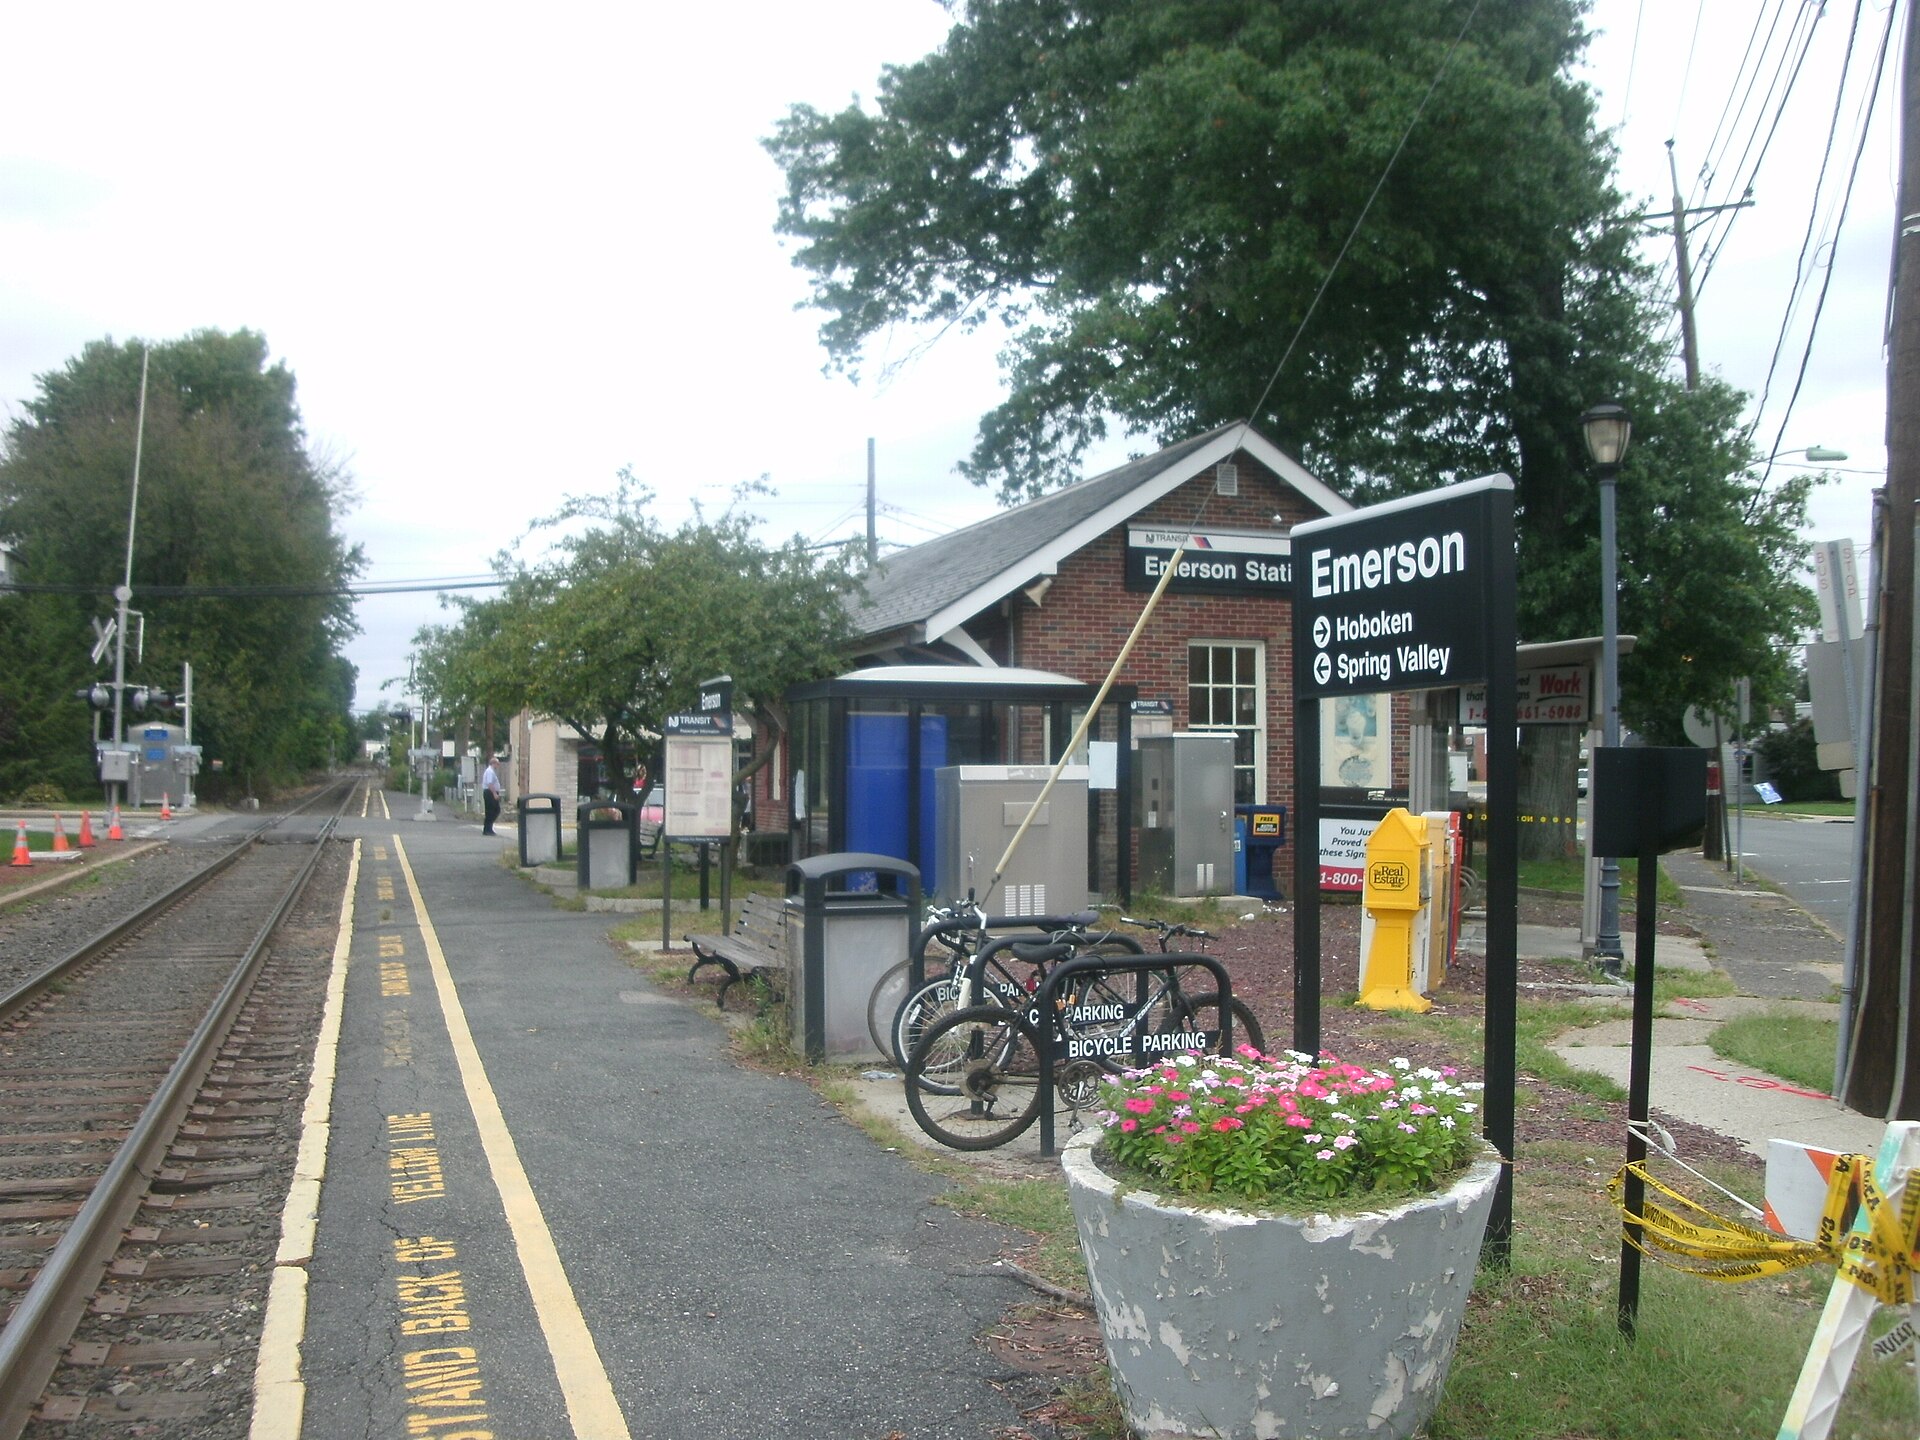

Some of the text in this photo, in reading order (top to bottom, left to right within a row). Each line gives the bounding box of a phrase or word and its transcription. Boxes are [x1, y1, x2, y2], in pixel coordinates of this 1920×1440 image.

[1156, 535, 1188, 544] TRANSIT
[1245, 561, 1292, 582] Stati
[1312, 531, 1465, 598] Emerson
[1816, 552, 1829, 590] BUS
[1843, 547, 1857, 598] STOP
[1336, 610, 1413, 642] Hoboken
[1337, 643, 1451, 684] Spring Valley
[1540, 671, 1580, 694] Work
[668, 716, 711, 727] NJ TRANSIT
[1332, 837, 1361, 847] Proved
[1340, 826, 1374, 836] You Jus
[1319, 849, 1343, 858] these
[1320, 871, 1364, 885] 1-800-
[1373, 874, 1404, 885] Estate
[1381, 866, 1404, 876] Real
[1068, 1003, 1124, 1021] ARKING
[1069, 1031, 1206, 1057] BICYCLE PARKING
[387, 1112, 435, 1143] LINE
[389, 1147, 446, 1204] YELLOW
[393, 1236, 458, 1263] OF
[396, 1270, 472, 1336] BACK
